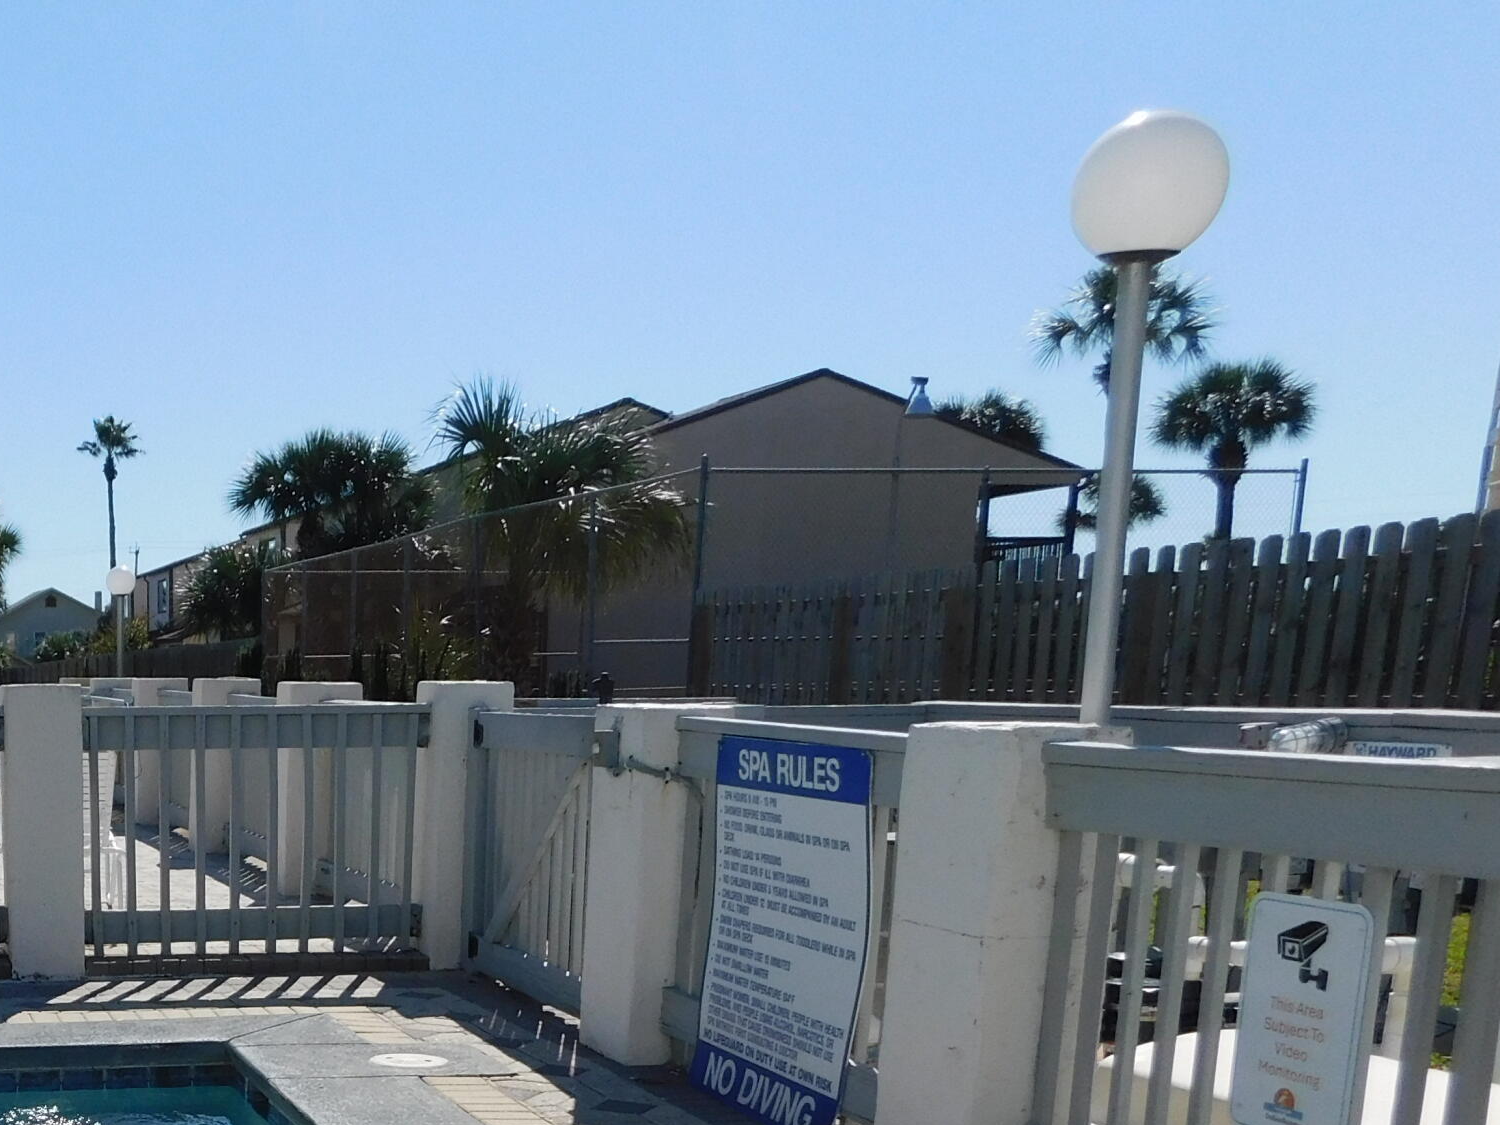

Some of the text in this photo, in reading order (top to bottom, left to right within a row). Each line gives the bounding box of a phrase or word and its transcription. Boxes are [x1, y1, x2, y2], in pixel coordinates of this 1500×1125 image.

[1368, 745, 1437, 758] HAYWARD
[738, 749, 840, 792] SPA RULES
[812, 836, 821, 846] SPA
[840, 840, 850, 852] SPA
[750, 865, 758, 876] SPA
[730, 876, 750, 889] CHILDREN
[819, 896, 828, 908] SPA
[722, 888, 742, 902] CHILDREN
[840, 918, 856, 930] ADULT
[732, 929, 741, 940] SPA
[776, 929, 786, 940] FOR
[786, 932, 794, 944] ALL
[822, 942, 838, 958] WHILE
[845, 950, 856, 962] SPA
[1270, 996, 1324, 1020] This Area
[824, 1022, 844, 1039] HEALTH
[1265, 1016, 1324, 1044] Subject To
[703, 1028, 834, 1094] NO LIFEGUARD ON DUTY USE AT OWN RISK
[1274, 1042, 1308, 1062] Video
[703, 1051, 736, 1096] NO
[1258, 1060, 1322, 1092] Monitoring
